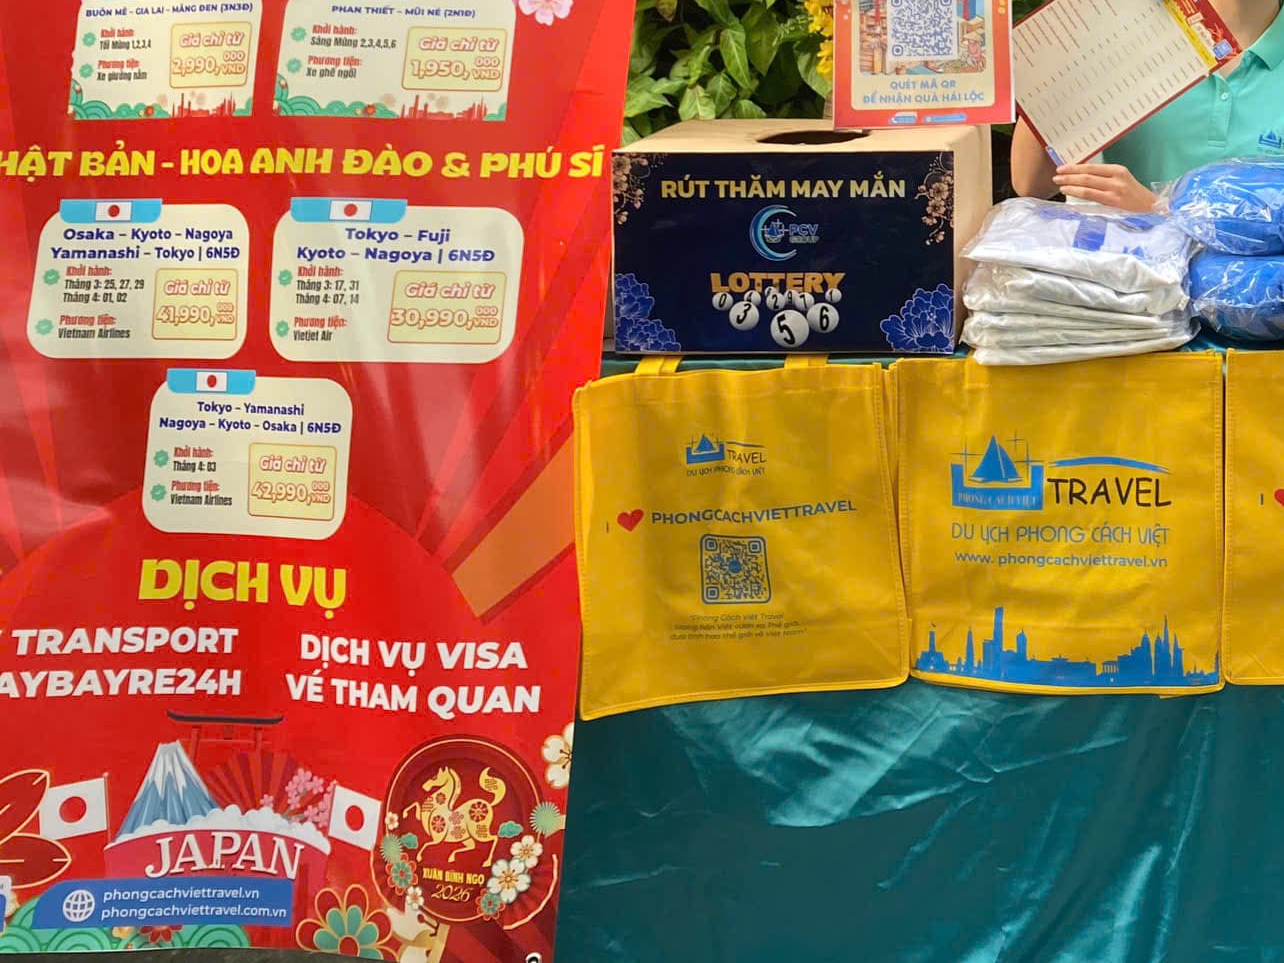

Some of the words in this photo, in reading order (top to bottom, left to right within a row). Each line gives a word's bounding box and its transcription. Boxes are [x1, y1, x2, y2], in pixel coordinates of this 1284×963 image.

[890, 78, 917, 90] QUÉT
[920, 79, 938, 89] MÃ
[941, 79, 956, 89] QR
[863, 91, 877, 104] ĐỂ
[880, 94, 912, 104] NHẬN
[915, 92, 939, 103] QUÀ
[942, 92, 961, 102] HÁI
[964, 92, 984, 102] LỘC
[0, 145, 72, 183] HẬT
[80, 140, 155, 177] BẢN
[180, 149, 243, 175] HOA
[251, 148, 333, 174] ANH
[343, 144, 433, 176] ĐÀO
[441, 152, 470, 178] &
[480, 146, 561, 178] PHÚ
[661, 174, 710, 198] RÚT
[715, 175, 785, 198] THĂM
[791, 180, 843, 198] MAY
[850, 171, 905, 198] MẮN
[64, 228, 114, 240] Osaka
[131, 228, 172, 243] Kyoto
[186, 228, 232, 243] Nagoya
[345, 228, 399, 243] Tokyo
[418, 229, 451, 245] Fuji
[789, 224, 819, 236] PCV
[51, 245, 140, 259] Yamanashi
[155, 247, 194, 261] Tokyo
[206, 247, 240, 259] 6N5Đ
[297, 247, 346, 261] Kyoto
[364, 248, 432, 263] Nagoya
[448, 249, 495, 262] 6N5Đ
[710, 272, 846, 294] LOTTERY
[736, 303, 752, 324] 3
[819, 306, 829, 330] 6
[58, 328, 96, 339] Vietnam
[98, 327, 130, 339] Airlines
[777, 315, 795, 345] 5
[1047, 477, 1172, 507] TRAVEL
[952, 523, 974, 540] DU
[1016, 526, 1085, 543] PHONG
[1092, 521, 1132, 543] CÁCH
[1138, 523, 1169, 547] VIỆT
[998, 553, 1167, 567] phongcachviettravel.vn
[138, 559, 269, 610] DỊCH
[280, 564, 346, 619] VỤ
[12, 627, 239, 655] TRANSPORT
[301, 634, 370, 669] DỊCH
[378, 641, 426, 677] VỤ
[436, 642, 528, 670] VISA
[0, 668, 241, 698] AYBAYRE24H
[285, 669, 324, 702] VÉ
[331, 678, 417, 713] THAM
[427, 685, 541, 720] QUAN
[145, 831, 304, 879] JAPAN
[103, 887, 260, 903] phongcachviettravel.vn
[432, 884, 473, 902] 2026
[100, 905, 287, 921] phongcachviettravel.com.vn
